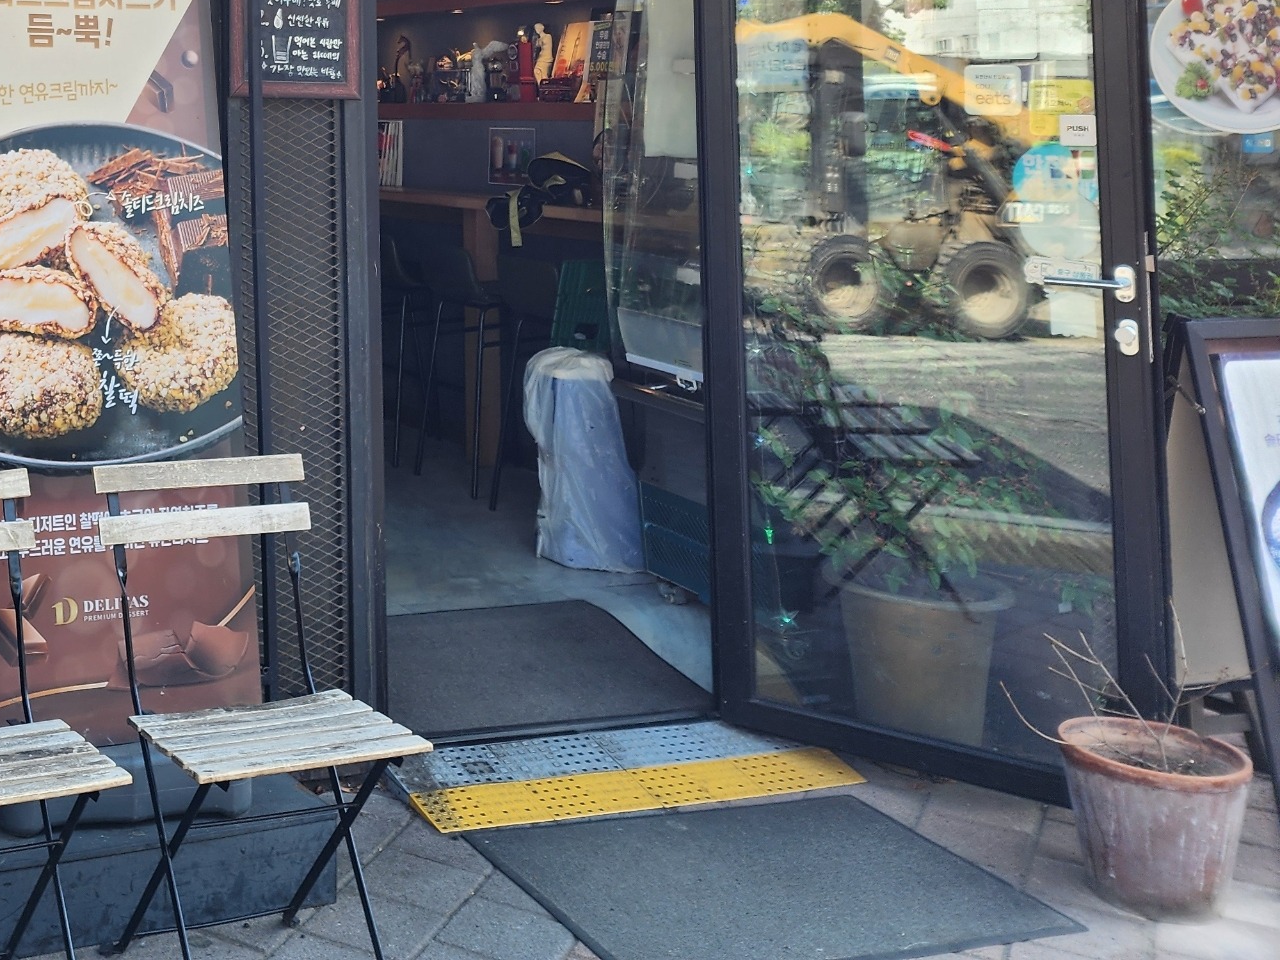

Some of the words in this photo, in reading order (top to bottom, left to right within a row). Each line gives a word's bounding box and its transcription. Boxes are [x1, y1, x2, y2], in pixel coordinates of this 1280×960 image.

[976, 94, 1011, 105] eats
[121, 191, 204, 219] 솔티드크림치즈
[99, 370, 139, 415] 찰떡
[83, 613, 116, 622] PREMIUM
[118, 609, 150, 619] DSSERT
